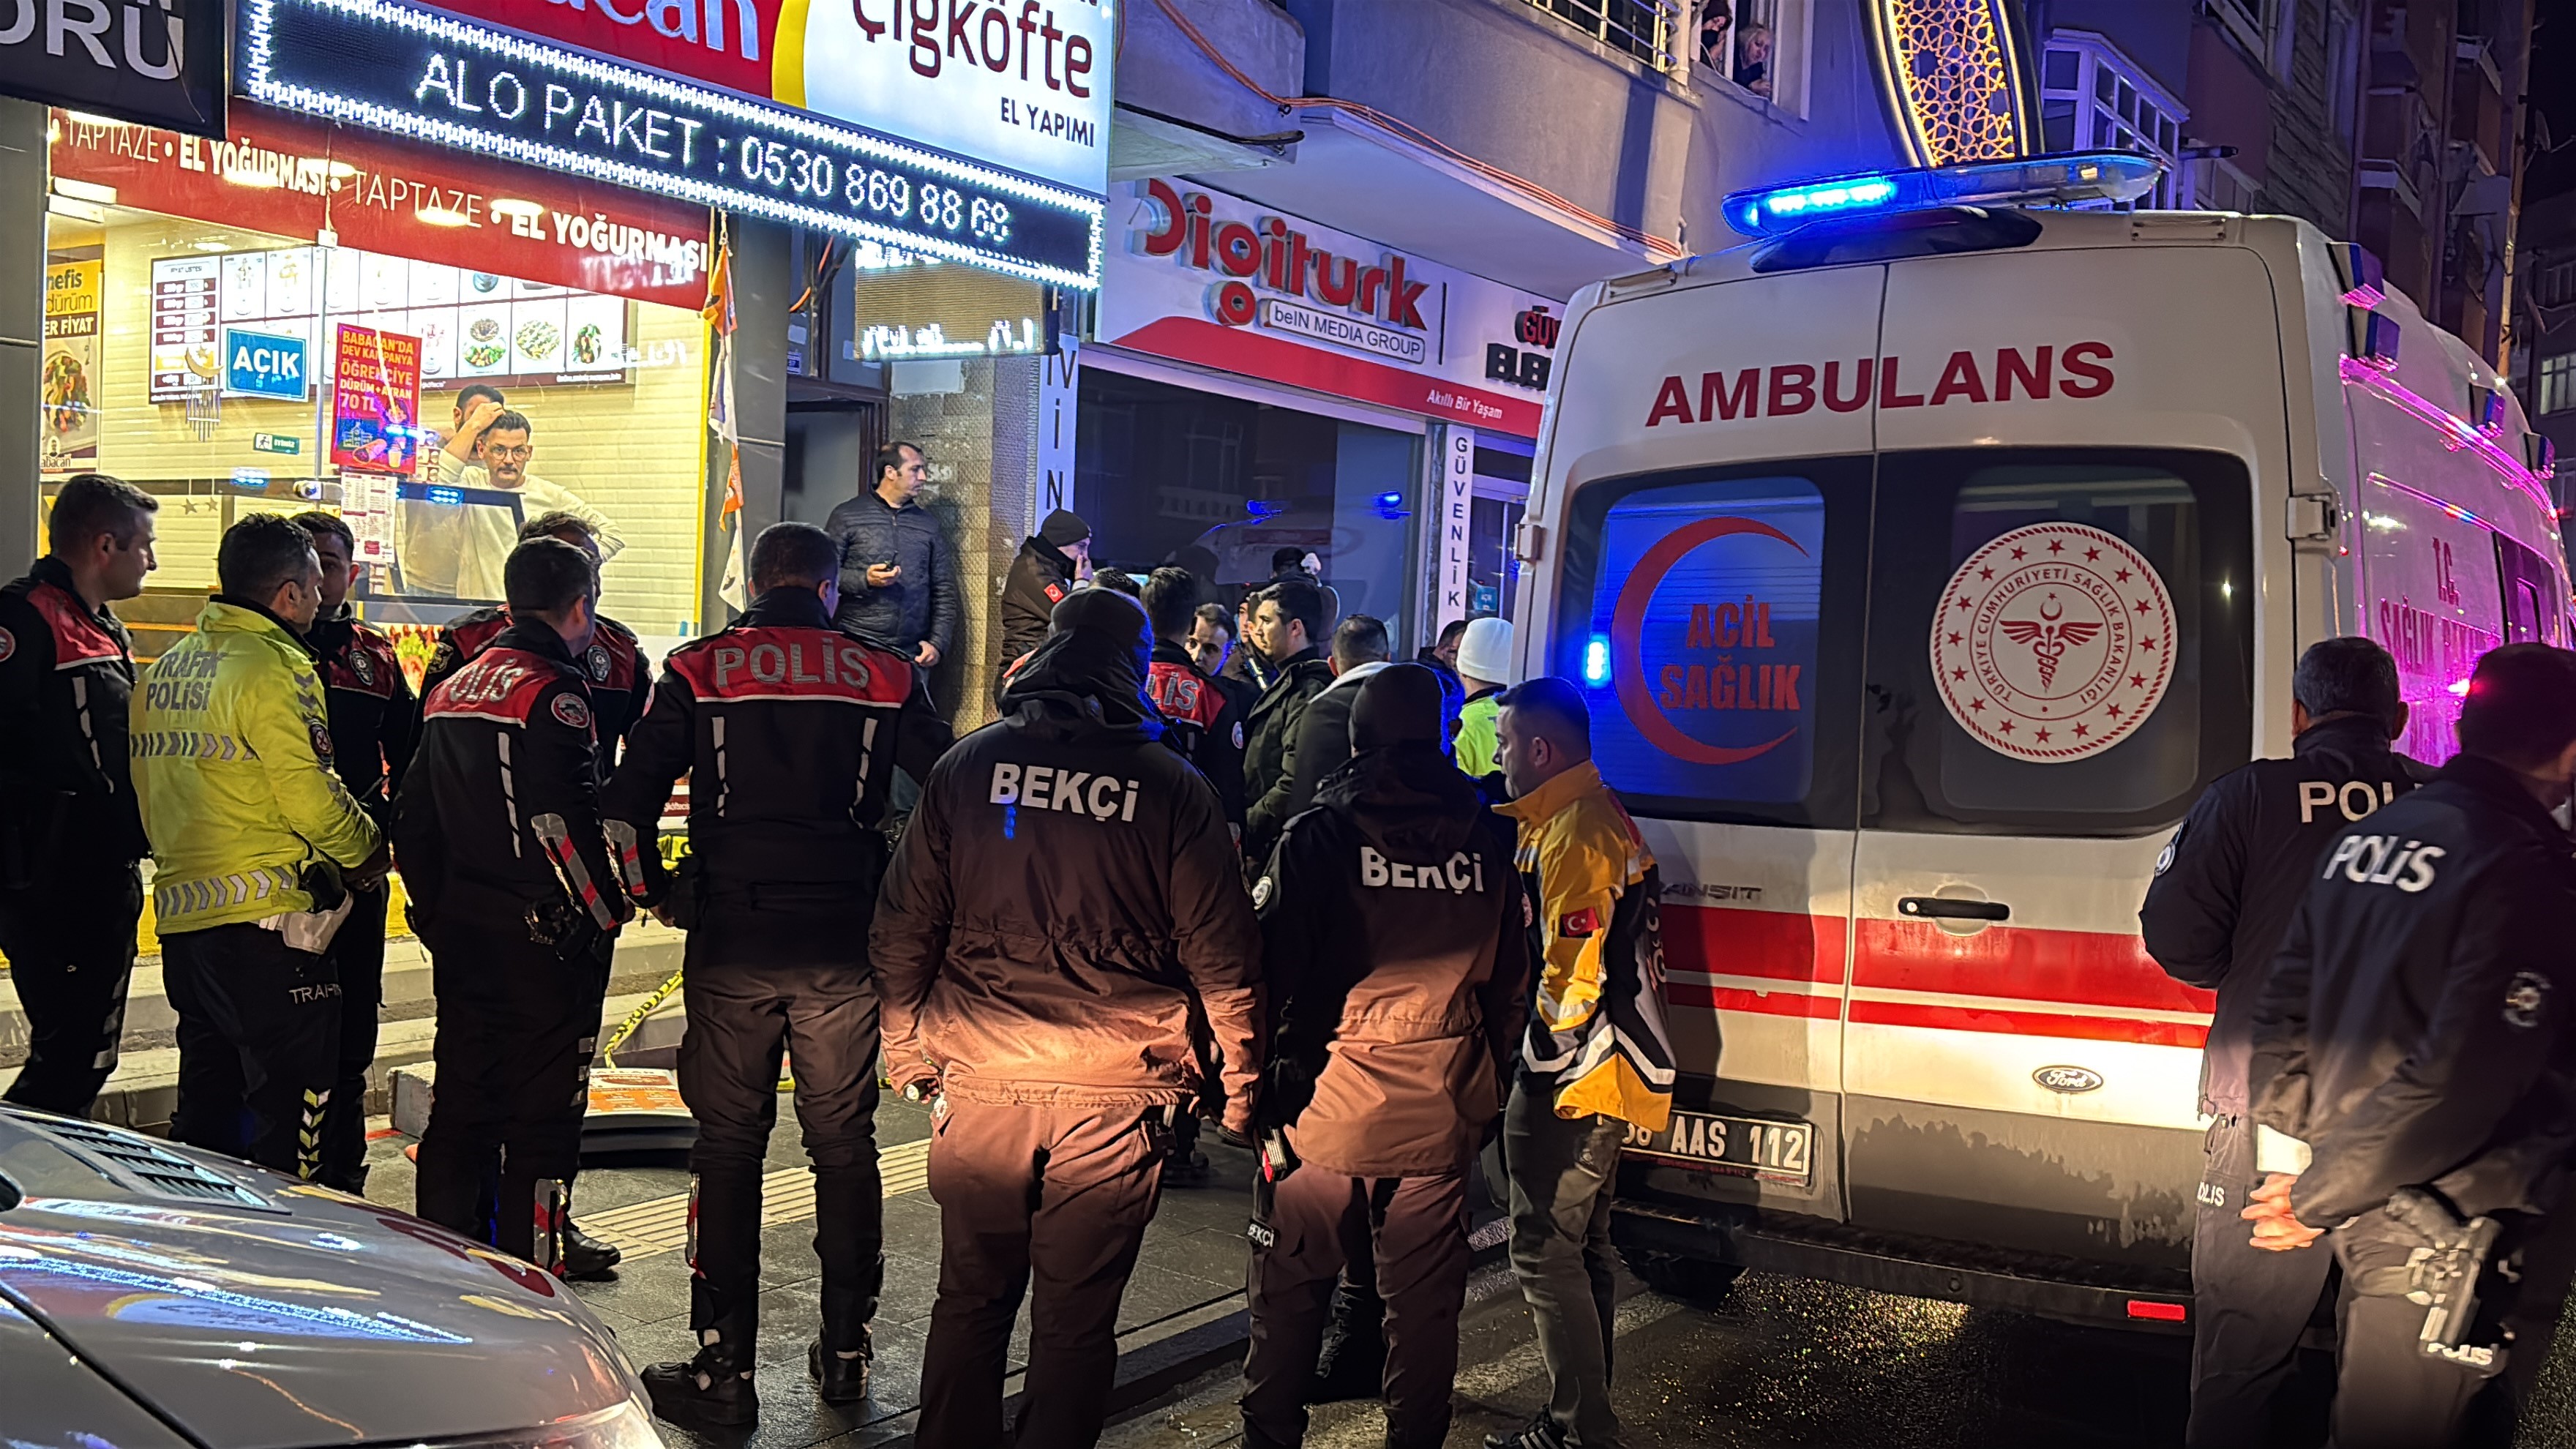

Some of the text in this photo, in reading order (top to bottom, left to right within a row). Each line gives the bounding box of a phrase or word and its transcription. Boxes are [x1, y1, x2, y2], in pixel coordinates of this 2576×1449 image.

[415, 53, 526, 120] ALO
[544, 83, 703, 166] PAKET
[741, 135, 834, 198] 0530
[845, 162, 911, 217] 869
[920, 184, 963, 231] 88
[1001, 97, 1095, 147] EL YAPIMI
[68, 119, 329, 197] TAPTAZE EL YOĞURMASI
[353, 171, 708, 272] TAPTAZE EL YOĞURMASI
[1138, 176, 1429, 329] Digiturk
[45, 293, 93, 313] dürüm
[61, 314, 94, 334] FİYAT
[341, 345, 413, 366] DEV KAPANYA
[1275, 305, 1420, 356] beIN MEDIA GROUP
[233, 345, 301, 380] AÇIK
[340, 378, 375, 392] DÜRÜM
[1645, 341, 2115, 427] AMBULANS
[340, 392, 378, 412] 70 TL
[1456, 395, 1472, 411] Bir
[1472, 400, 1502, 419] Yaşam
[1447, 436, 1468, 607] GÜVENLİK
[1977, 567, 2070, 635] CUMHURİYETİ
[2072, 572, 2122, 618] SAĞLIK
[1686, 594, 1775, 649] ACİL
[439, 657, 525, 703] OLİS
[714, 637, 870, 689] POLİS
[1659, 654, 1801, 711] SAĞLIK
[2079, 621, 2126, 705] BAKANLIĞI
[2299, 780, 2424, 823] PO
[2322, 834, 2447, 893] POLİS
[2046, 1068, 2089, 1087] Ford
[1670, 1115, 1727, 1158] AAS
[1749, 1125, 1804, 1169] 112
